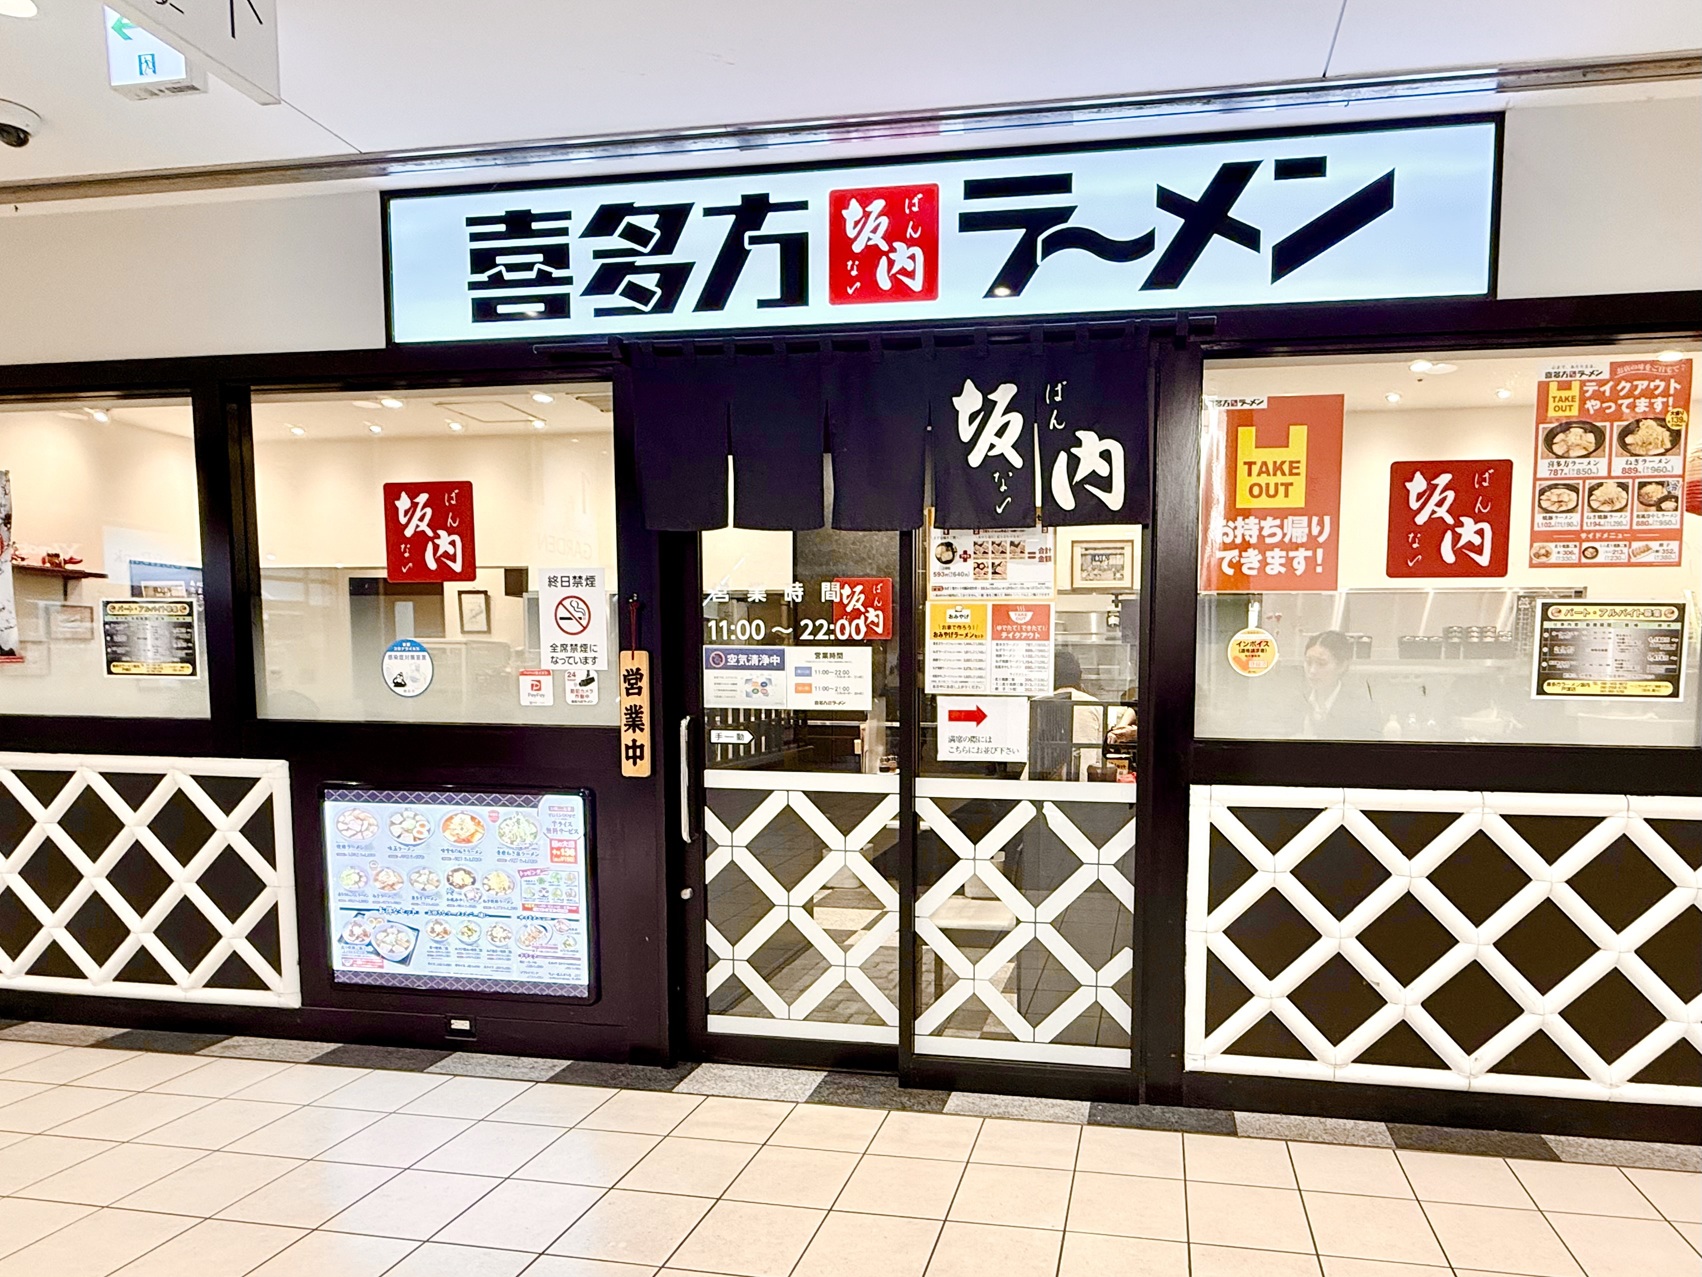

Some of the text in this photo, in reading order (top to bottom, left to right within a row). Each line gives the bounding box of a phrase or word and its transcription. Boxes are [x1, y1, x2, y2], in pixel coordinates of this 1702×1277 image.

[905, 193, 923, 239] ばん
[465, 156, 1396, 323] 喜多方 坂内 ラーメン
[846, 259, 861, 296] ない
[1551, 395, 1577, 404] TAKE
[1583, 378, 1682, 398] テイクアウト
[1046, 380, 1069, 432] ばん
[1553, 404, 1574, 413] OUT
[1584, 396, 1674, 415] やってます！
[951, 378, 1125, 511] 坂内
[1243, 459, 1301, 478] TAKE
[993, 471, 1012, 515] ない
[1248, 481, 1294, 499] OUT
[1473, 468, 1494, 514] ばん
[444, 489, 460, 528] ばん
[1404, 470, 1493, 567] 坂内
[394, 491, 463, 573] 坂内
[1216, 514, 1331, 543] お持ち帰り
[400, 543, 413, 573] ない
[1216, 547, 1324, 577] できます！
[1406, 531, 1423, 567] ない
[547, 574, 597, 589] 終日禁煙
[708, 620, 766, 641] 11:00
[800, 620, 866, 641] 22:00
[550, 642, 598, 654] 全席禁煙に
[550, 656, 599, 666] なっています
[726, 654, 781, 667] 空気清浄中
[814, 652, 844, 660] 営業時間
[622, 666, 646, 768] 営業中
[948, 746, 1020, 755] こちらにお並び下さい
